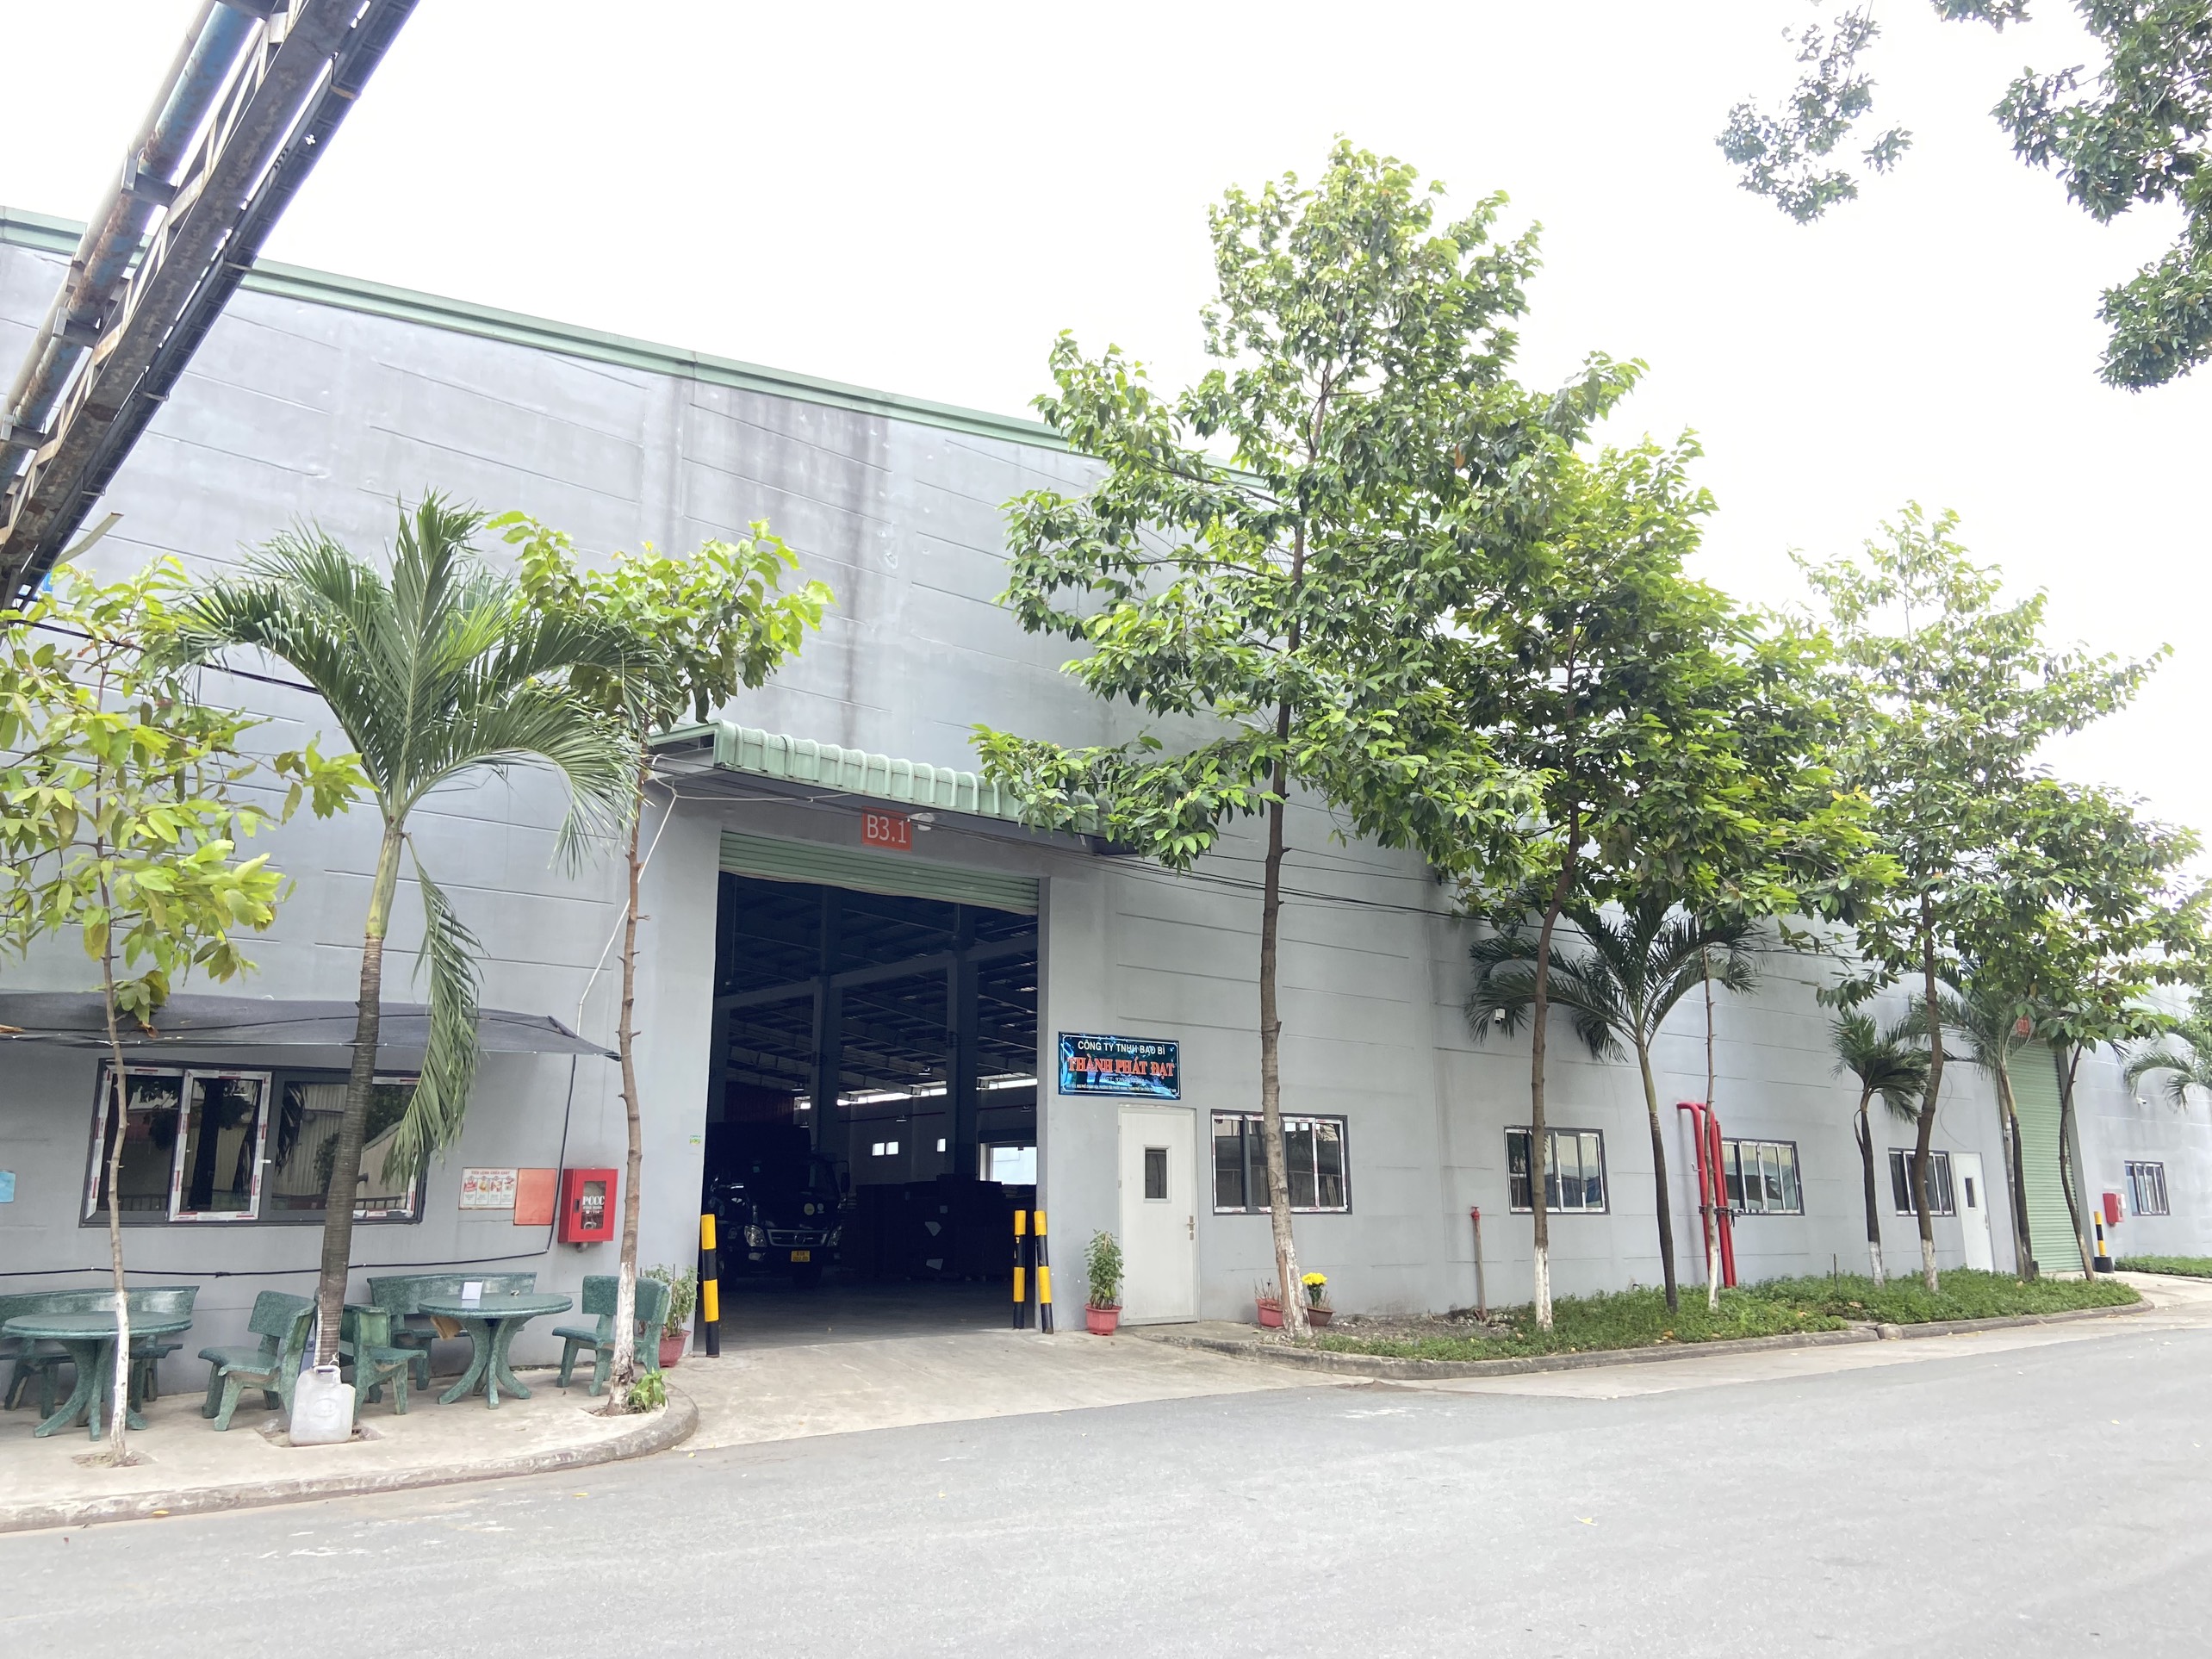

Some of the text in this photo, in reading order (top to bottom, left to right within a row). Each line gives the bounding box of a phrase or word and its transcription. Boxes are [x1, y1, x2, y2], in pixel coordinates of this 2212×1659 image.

[867, 814, 906, 843] B3.1
[1078, 1039, 1102, 1050] CÔNG
[1103, 1043, 1114, 1052] TY
[1116, 1043, 1138, 1053] TNHH
[1158, 1044, 1165, 1055] BÌ
[1067, 1053, 1176, 1080] THÀNH PHÁT ĐẠT
[582, 1196, 605, 1205] PCCC
